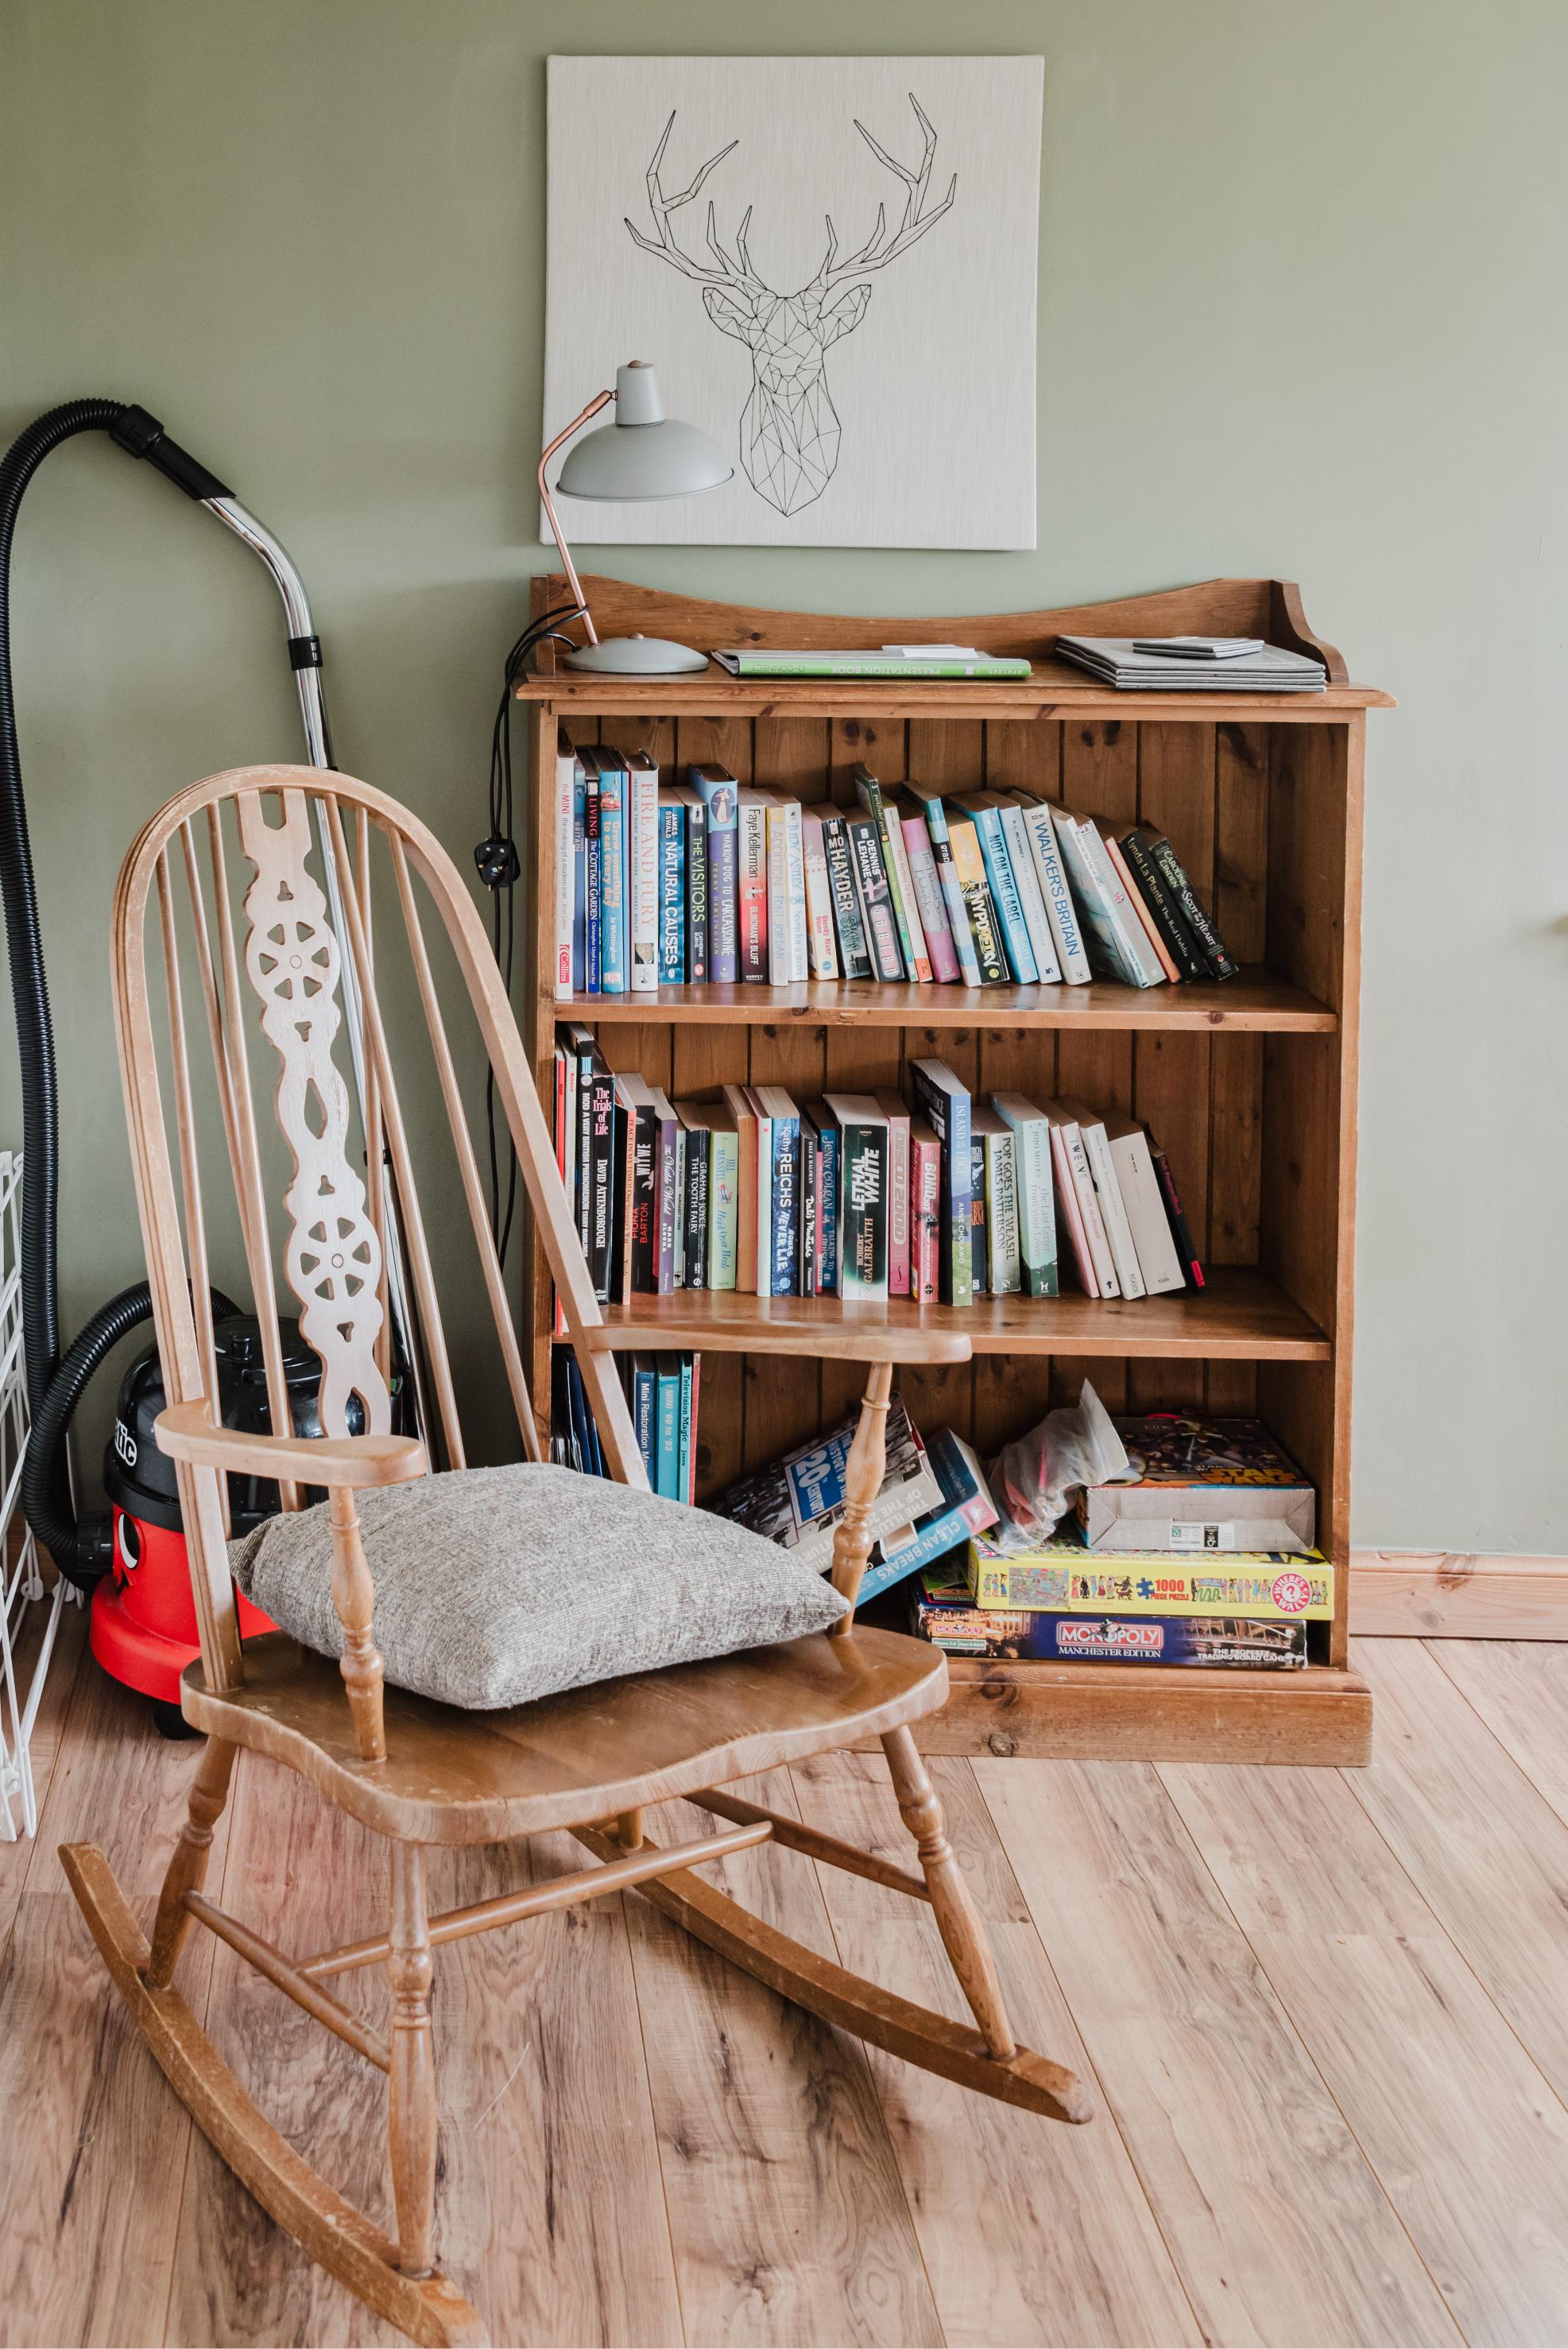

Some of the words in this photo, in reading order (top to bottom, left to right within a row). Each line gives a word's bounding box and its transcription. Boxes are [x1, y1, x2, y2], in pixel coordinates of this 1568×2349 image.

[828, 666, 860, 675] BOOK
[865, 666, 941, 675] PRESENTATION
[590, 798, 598, 836] LIVING
[641, 784, 654, 826] FIRE
[604, 822, 611, 831] to
[745, 809, 761, 831] Faye
[562, 847, 568, 857] of
[641, 833, 654, 873] AND
[693, 837, 702, 856] THE
[722, 834, 731, 863] NARROW
[749, 834, 760, 877] Kellerman
[829, 837, 844, 849] MO
[866, 839, 881, 876] DENNIS
[989, 834, 1004, 853] NOT
[589, 853, 598, 887] COTTAGE
[602, 854, 611, 883] every
[665, 842, 677, 905] NATURAL
[723, 866, 732, 881] DOG
[858, 840, 873, 878] LEHANE
[994, 857, 1006, 869] ON
[1128, 837, 1143, 864] Lynda
[1140, 864, 1150, 877] La
[1146, 876, 1164, 905] Plante
[1164, 850, 1187, 887] CAROLINE
[611, 853, 621, 907] something
[830, 849, 854, 912] HAYDER
[998, 873, 1012, 892] THE
[1160, 860, 1179, 888] LINDEN
[602, 887, 612, 907] day
[691, 858, 704, 922] VISITORS
[1035, 822, 1065, 897] WALKER'S
[1055, 900, 1079, 956] BRITAIN
[641, 881, 654, 927] FURY
[1002, 895, 1020, 924] LABEL
[665, 907, 678, 964] CAUSES
[722, 900, 734, 955] CARCASSONNE
[749, 907, 758, 943] BLINDMAN'S
[841, 916, 860, 952] SKIN
[1161, 907, 1171, 919] The
[1168, 920, 1179, 934] Red
[1175, 934, 1188, 957] Dahlia
[593, 1100, 612, 1112] Trials
[596, 1088, 610, 1098] The
[595, 1124, 609, 1135] Life
[956, 1106, 965, 1139] ISLAND
[628, 1144, 633, 1152] IN
[780, 1127, 790, 1152] Kathy
[597, 1159, 607, 1182] DAVID
[628, 1154, 633, 1165] MY
[637, 1144, 650, 1175] WITWE
[664, 1156, 674, 1183] Visible
[716, 1150, 725, 1182] MANSELL
[726, 1159, 735, 1171] JILL
[895, 1132, 904, 1184] DISCO
[956, 1151, 965, 1175] EDGE
[993, 1151, 1003, 1185] JAMES
[1070, 1139, 1087, 1180] TWELVE
[780, 1154, 792, 1207] REICHS
[852, 1158, 865, 1211] LETHAL
[865, 1147, 879, 1203] WHITE
[663, 1186, 674, 1215] World
[1030, 1185, 1040, 1207] from
[1040, 1189, 1049, 1203] the
[596, 1184, 606, 1248] ATTENBOROUGH
[717, 1210, 726, 1230] Head
[895, 1187, 904, 1239] 2000
[995, 1188, 1005, 1250] PATTERSON
[1031, 1209, 1040, 1230] your
[718, 1231, 728, 1248] Over
[777, 1211, 790, 1245] NEVER
[1005, 1217, 1014, 1260] WEASEL
[1043, 1226, 1051, 1252] Letter
[721, 1250, 731, 1269] Heels
[777, 1247, 787, 1271] LIE
[864, 1218, 873, 1283] GALBRAITH
[1034, 1233, 1043, 1258] Lover
[665, 1426, 672, 1435] to
[796, 1449, 831, 1488] 20
[1206, 1468, 1291, 1476] STAR
[921, 1519, 962, 1549] CLEAN
[876, 1545, 924, 1582] BREAKS
[1156, 1580, 1184, 1592] 1000
[1273, 1573, 1306, 1594] WHERE'S
[1277, 1589, 1310, 1612] WALLY
[1061, 1627, 1159, 1645] MONOPOLY
[1058, 1647, 1121, 1657] MANCHESTER
[1124, 1648, 1161, 1658] EDITION
